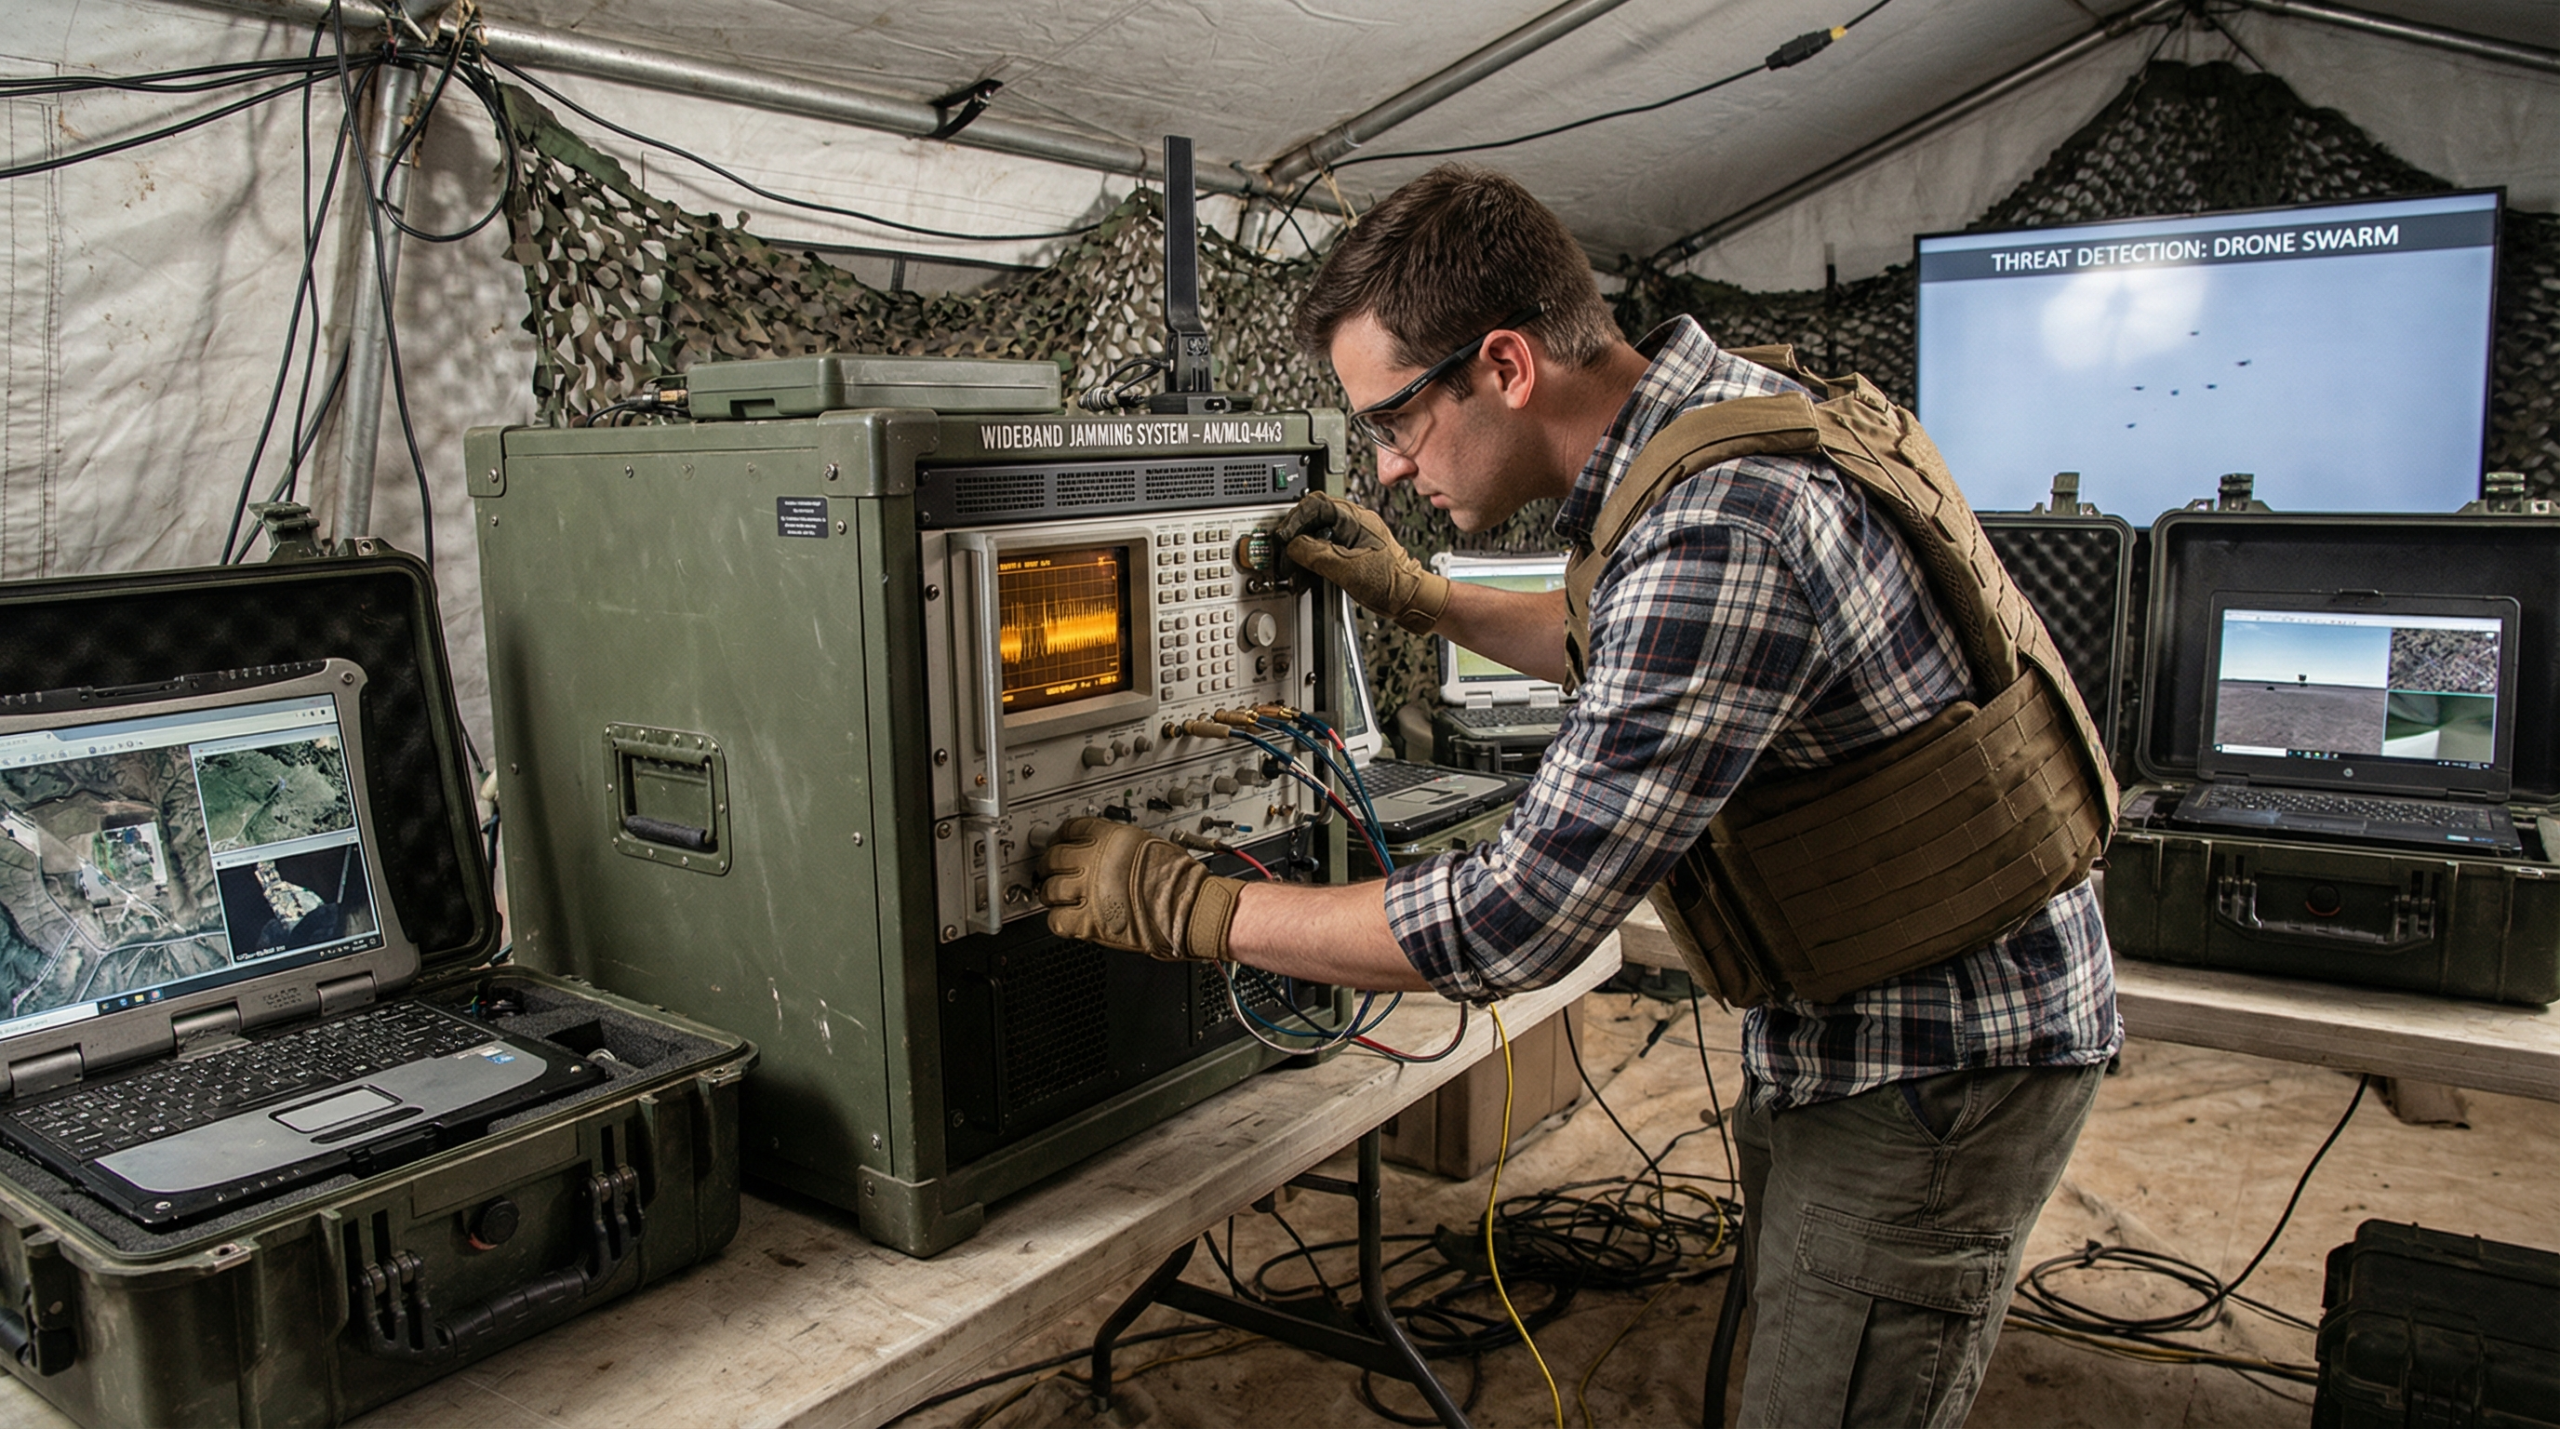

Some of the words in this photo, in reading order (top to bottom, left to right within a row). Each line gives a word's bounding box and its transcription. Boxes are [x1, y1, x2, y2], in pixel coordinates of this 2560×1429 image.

[1991, 249, 2072, 272] THREAT
[2077, 239, 2207, 267] DETECTION:
[2214, 232, 2296, 258] DRONE
[2302, 224, 2399, 251] SWARM
[981, 424, 1063, 450] WIDEBAND
[1069, 423, 1133, 448] JAMMING
[1137, 422, 1189, 446] SYSTEM
[1202, 421, 1282, 445] AN/MLQ-44v3
